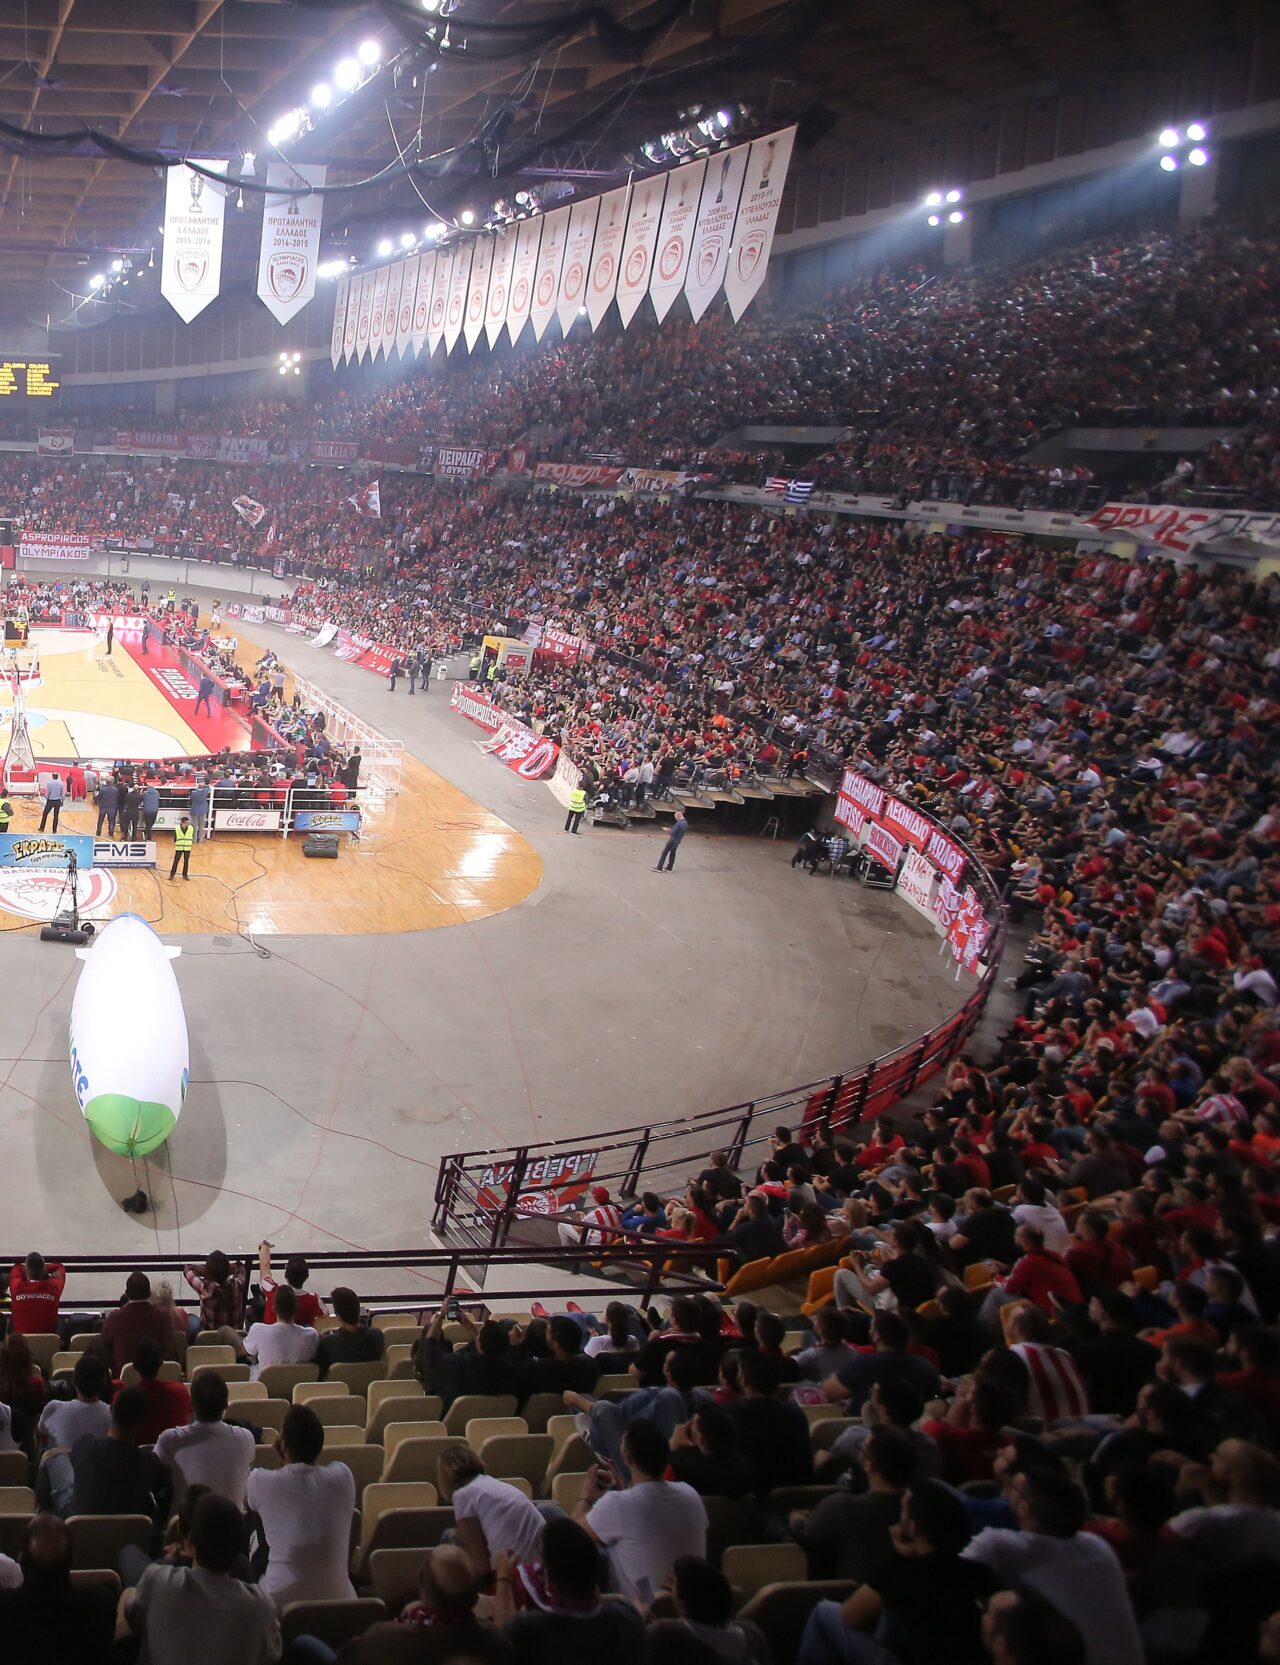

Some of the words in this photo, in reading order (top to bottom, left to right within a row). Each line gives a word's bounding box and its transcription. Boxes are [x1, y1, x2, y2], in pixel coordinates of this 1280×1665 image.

[268, 217, 317, 228] ΠΡΩΤΑΘΛΗΤΗΣ
[276, 229, 308, 238] ΕΛΛΑΔΟΣ
[273, 239, 309, 248] 2014-2015
[21, 532, 90, 544] ASPROPIRGOS
[22, 547, 89, 559] OLYMPIAKOS
[94, 844, 147, 857] FMS
[16, 1293, 55, 1301] OLYMPIACOS
